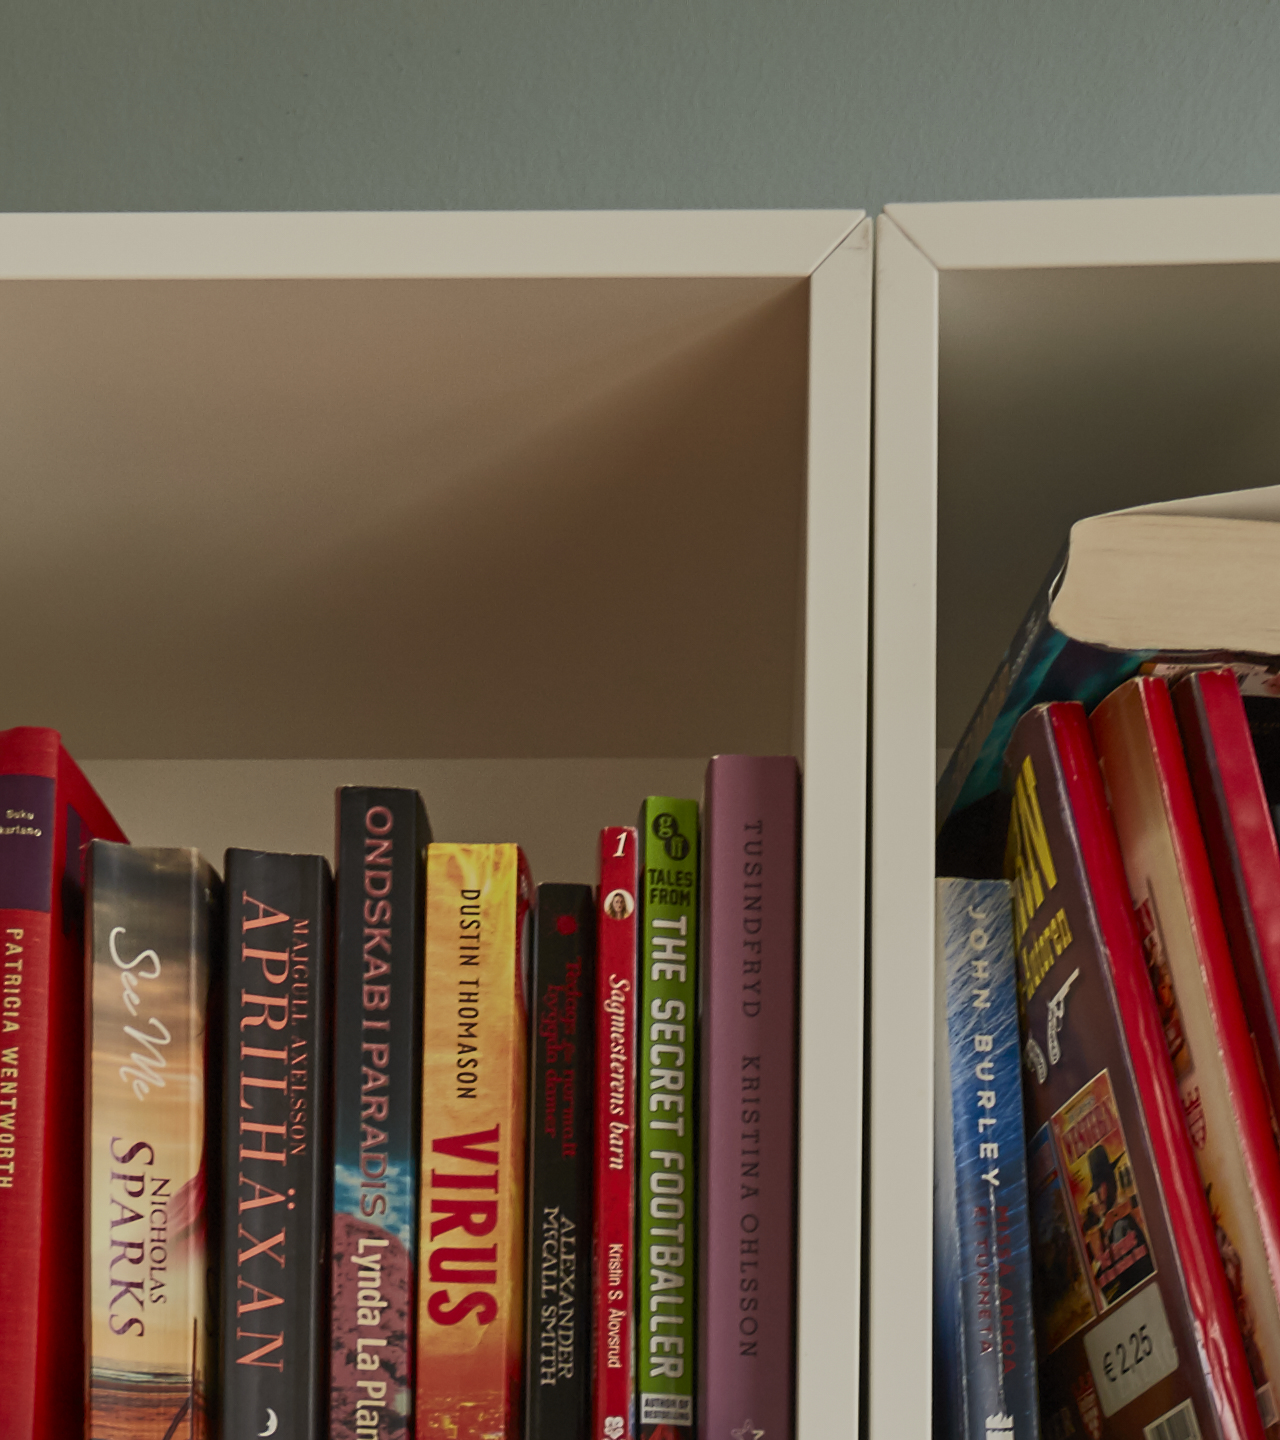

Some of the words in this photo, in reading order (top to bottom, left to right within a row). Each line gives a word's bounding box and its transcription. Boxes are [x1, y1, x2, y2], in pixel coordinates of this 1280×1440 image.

[363, 805, 392, 1012] ONDSKAB
[460, 889, 480, 967] DUSTIN
[648, 868, 692, 887] TALES
[650, 889, 691, 908] FROM
[650, 915, 687, 982] THE
[742, 820, 762, 1017] TUSINDFRYD
[3, 927, 24, 1034] PATRICIA
[363, 1019, 391, 1029] I
[456, 977, 479, 1100] THOMASON
[236, 890, 295, 1372] APRILHÄXAN
[357, 1041, 392, 1217] PARADIS
[648, 998, 686, 1136] SECRET
[740, 1055, 761, 1201] KRISTINA
[110, 1136, 155, 1339] SPARKS
[149, 1175, 171, 1305] NICHOLAS
[427, 1122, 502, 1328] VIRUS
[648, 1149, 684, 1380] FOOTBALLER
[739, 1211, 760, 1358] OHLSSON
